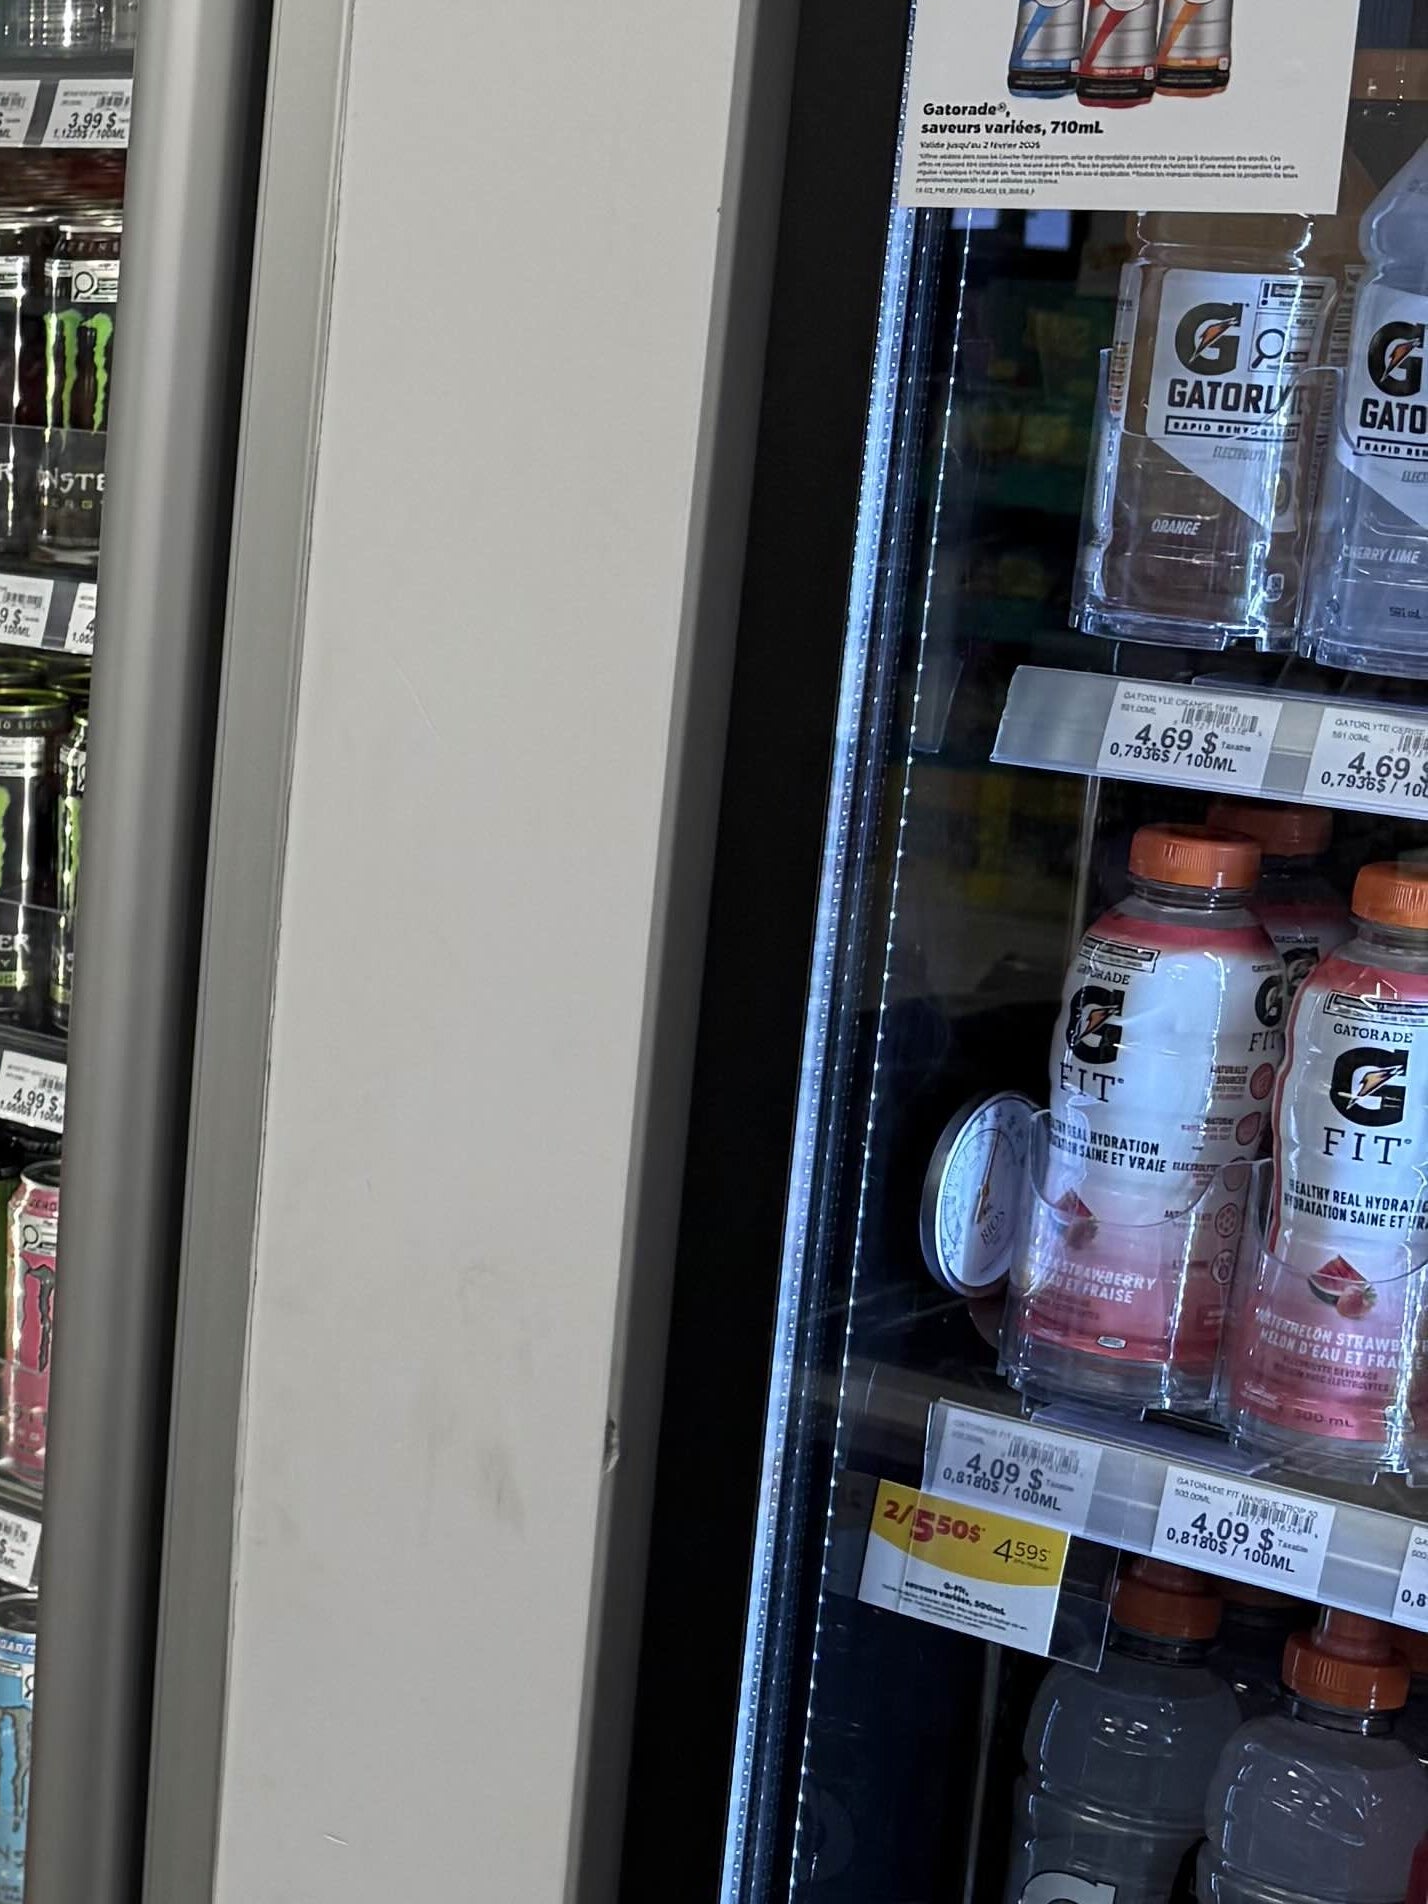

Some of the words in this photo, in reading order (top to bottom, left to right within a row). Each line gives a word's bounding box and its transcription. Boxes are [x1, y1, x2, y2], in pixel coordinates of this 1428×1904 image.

[921, 121, 981, 134] saveurs
[984, 119, 1046, 136] variées,
[1050, 120, 1104, 134] 710mL
[1174, 422, 1211, 431] RAPID
[1364, 442, 1401, 455] RAPID
[1151, 519, 1201, 535] ORANGE
[1389, 548, 1420, 564] LIME
[1186, 753, 1237, 772] 100ML
[1334, 1023, 1413, 1043] GATORADE
[1090, 1131, 1160, 1156] HYDRATION
[1079, 1144, 1109, 1163] SAINE
[1111, 1151, 1126, 1167] ET
[1128, 1154, 1167, 1173] VRAIE
[1333, 1190, 1361, 1207] REAL
[1350, 1211, 1385, 1227] SAINE
[1388, 1214, 1404, 1229] ET
[1083, 1284, 1134, 1304] FRAISE
[1299, 1343, 1340, 1361] D'EAU
[1345, 1350, 1364, 1366] ET
[1028, 1468, 1043, 1492] $
[1176, 1477, 1225, 1494] GATORADE
[1013, 1486, 1061, 1511] 100ML
[1258, 1527, 1274, 1552] $
[1243, 1549, 1295, 1573] 100ML
